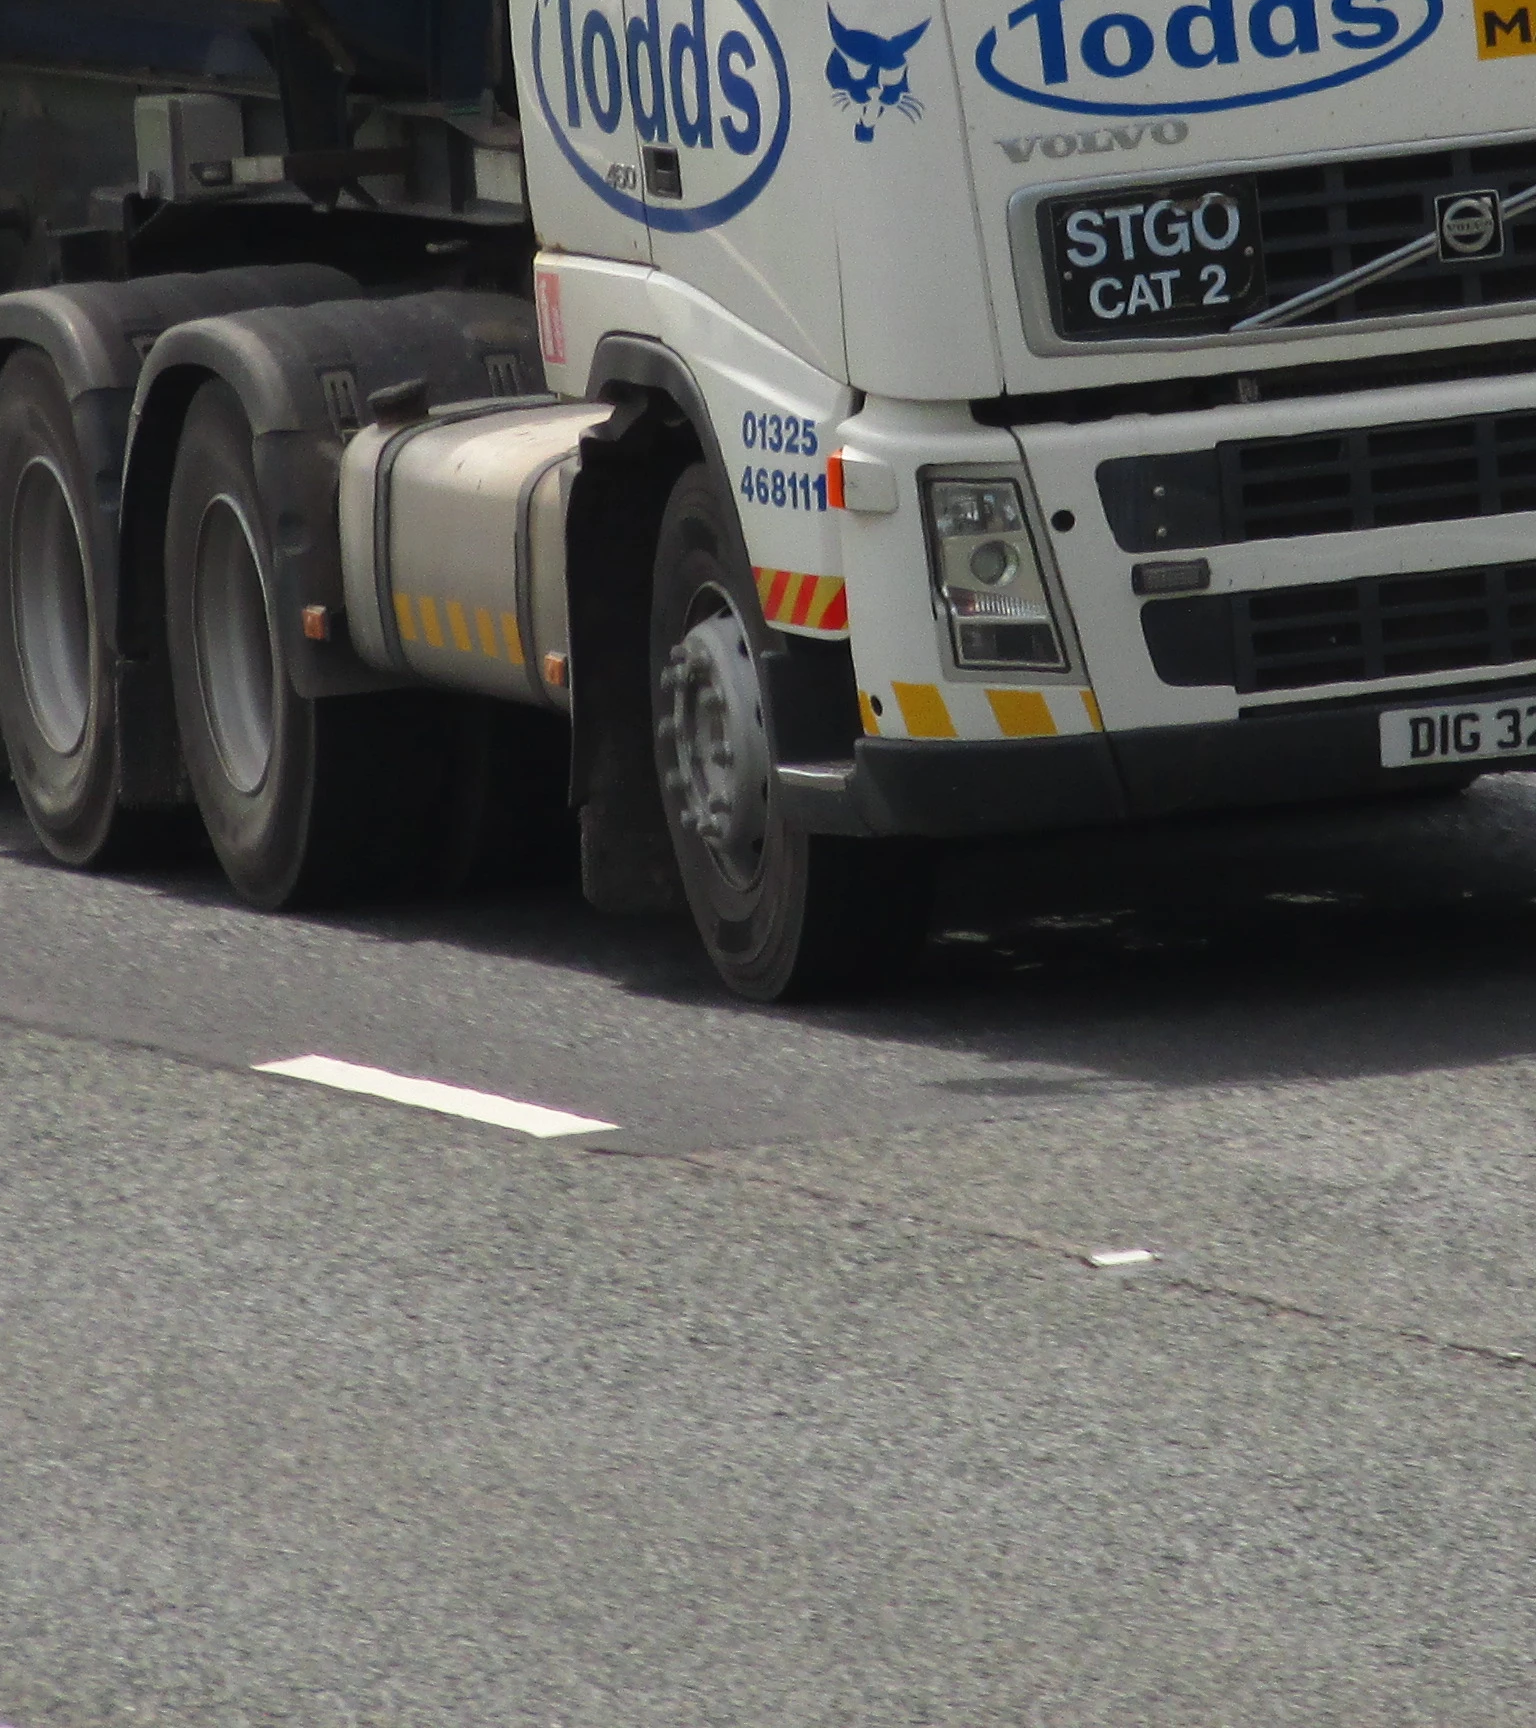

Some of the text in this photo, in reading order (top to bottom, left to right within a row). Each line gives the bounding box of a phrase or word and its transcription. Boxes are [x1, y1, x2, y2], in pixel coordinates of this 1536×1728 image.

[994, 117, 1190, 164] VOLVO
[1066, 192, 1240, 268] STGO
[1089, 264, 1231, 320] CAT 2
[742, 410, 819, 457] 01325
[740, 465, 827, 512] 468111
[1409, 712, 1481, 759] DIG
